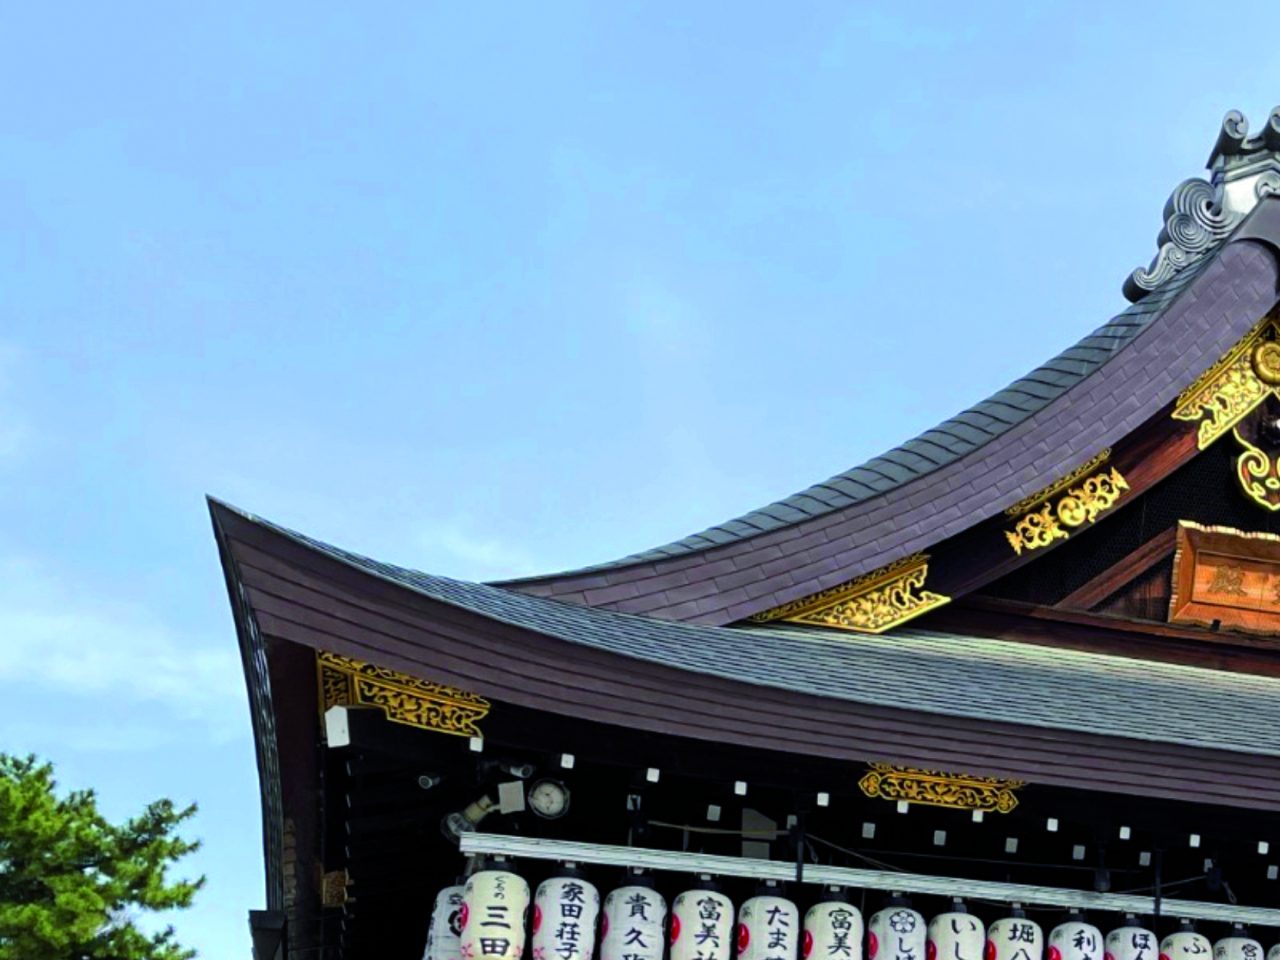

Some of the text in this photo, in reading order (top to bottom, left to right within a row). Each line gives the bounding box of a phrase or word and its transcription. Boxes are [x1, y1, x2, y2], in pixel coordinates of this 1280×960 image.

[480, 905, 511, 956] 三田
[556, 882, 586, 960] 家田荘子
